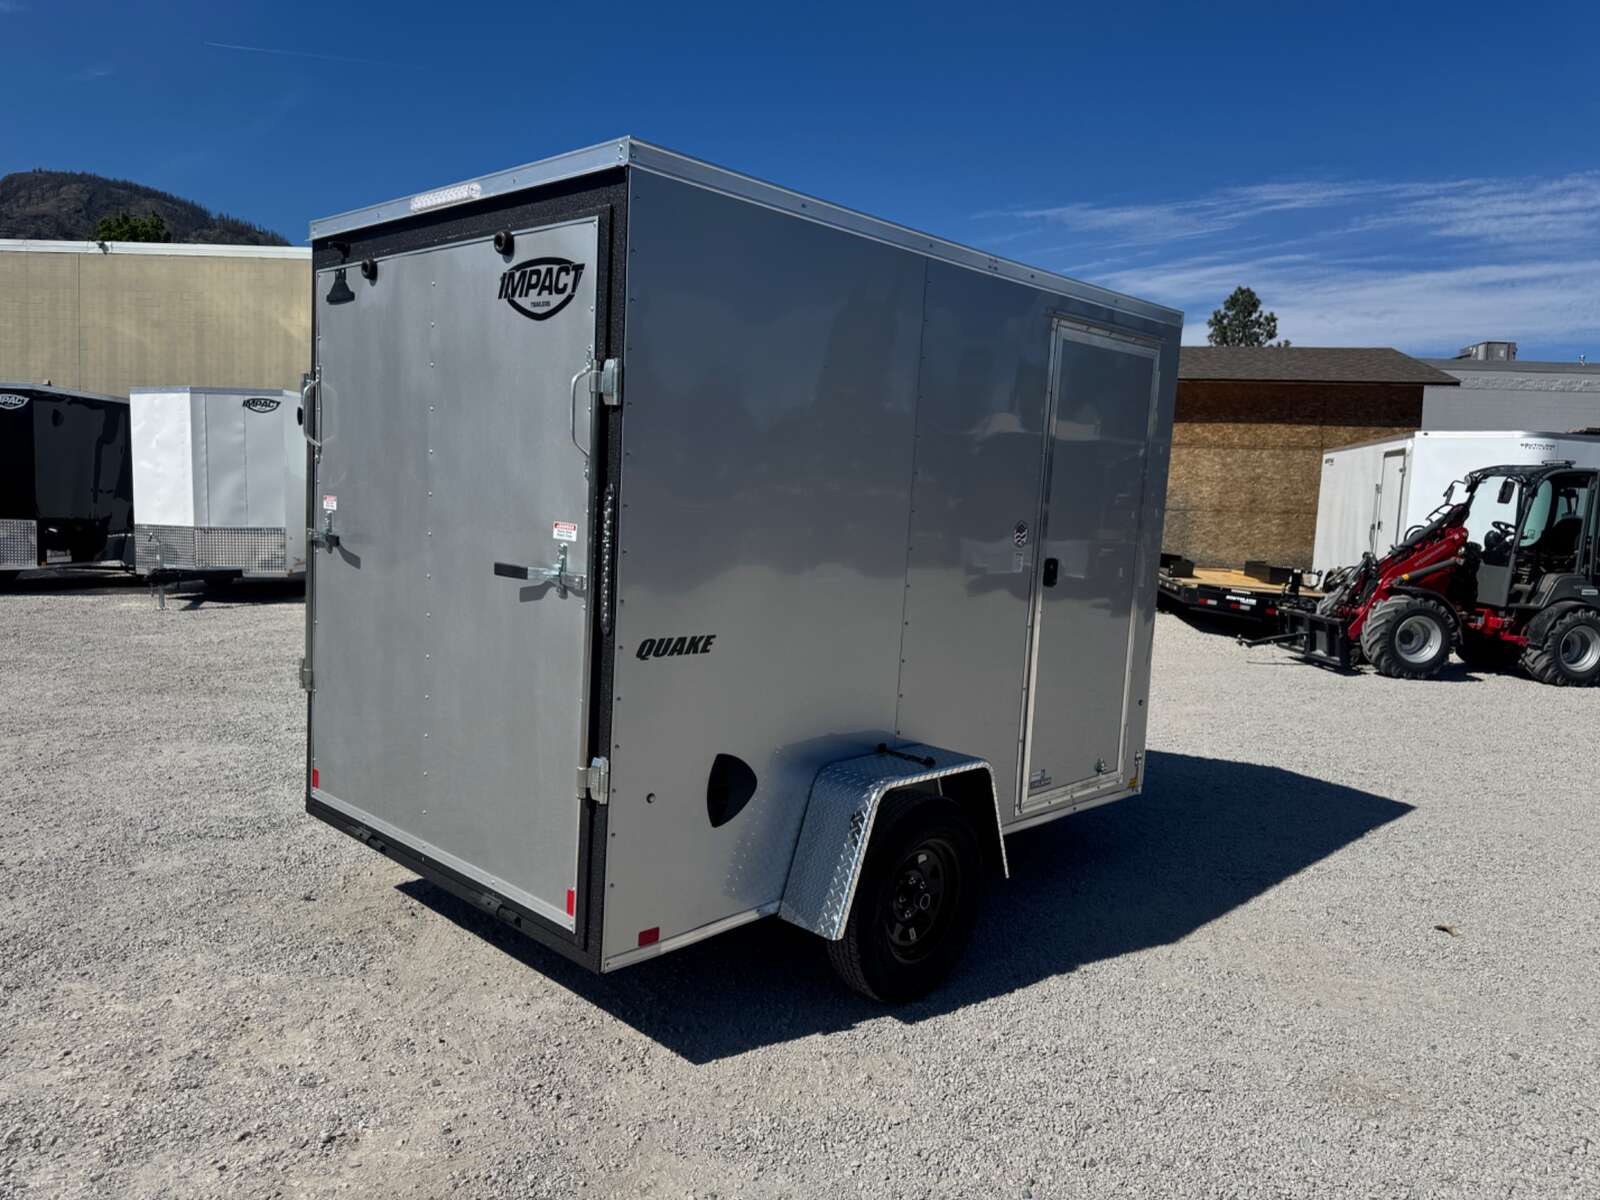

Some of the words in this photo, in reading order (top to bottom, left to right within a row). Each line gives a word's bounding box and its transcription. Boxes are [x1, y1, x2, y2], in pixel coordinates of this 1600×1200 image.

[498, 263, 585, 299] IMPACT
[243, 399, 281, 408] IMPACT
[636, 634, 717, 661] QUAKE
